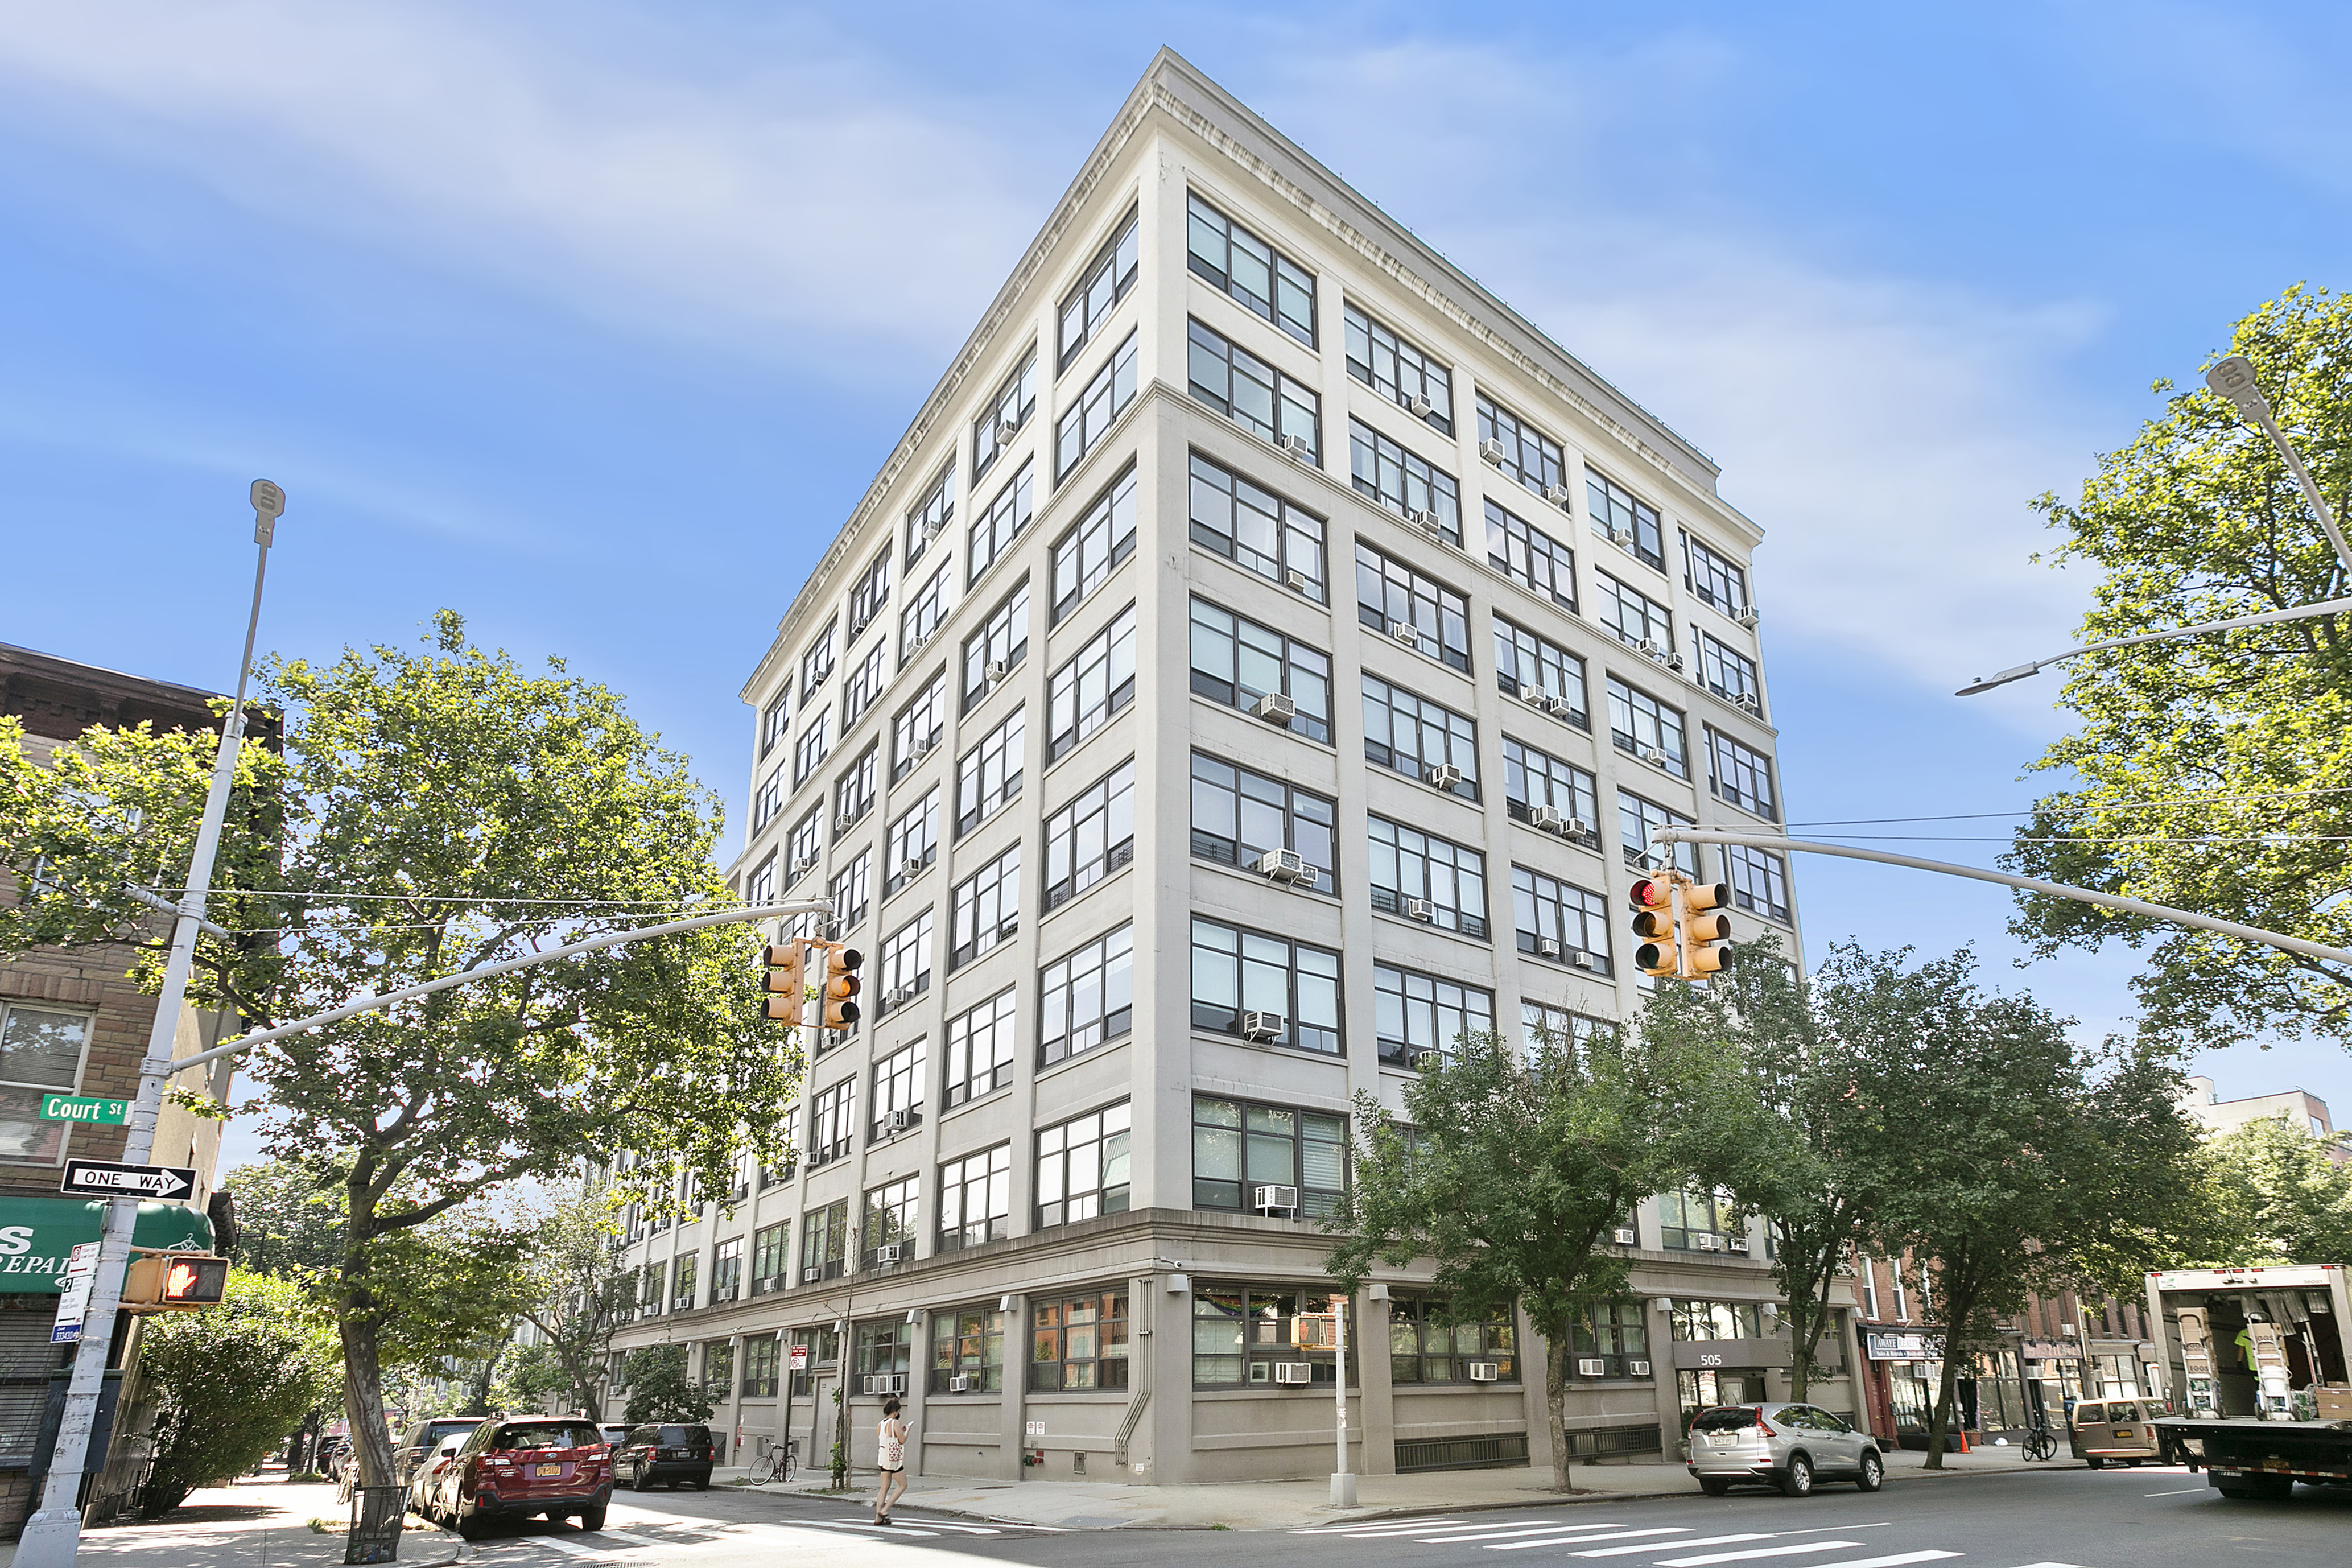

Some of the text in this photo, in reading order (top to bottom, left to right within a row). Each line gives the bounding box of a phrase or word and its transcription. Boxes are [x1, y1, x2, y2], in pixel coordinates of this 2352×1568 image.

[48, 1097, 122, 1120] Court St
[85, 1171, 176, 1189] ONE WAY
[0, 1256, 71, 1274] EPAI
[64, 1278, 72, 1292] 2
[1899, 1339, 1919, 1348] REALTY
[1701, 1354, 1722, 1366] 505
